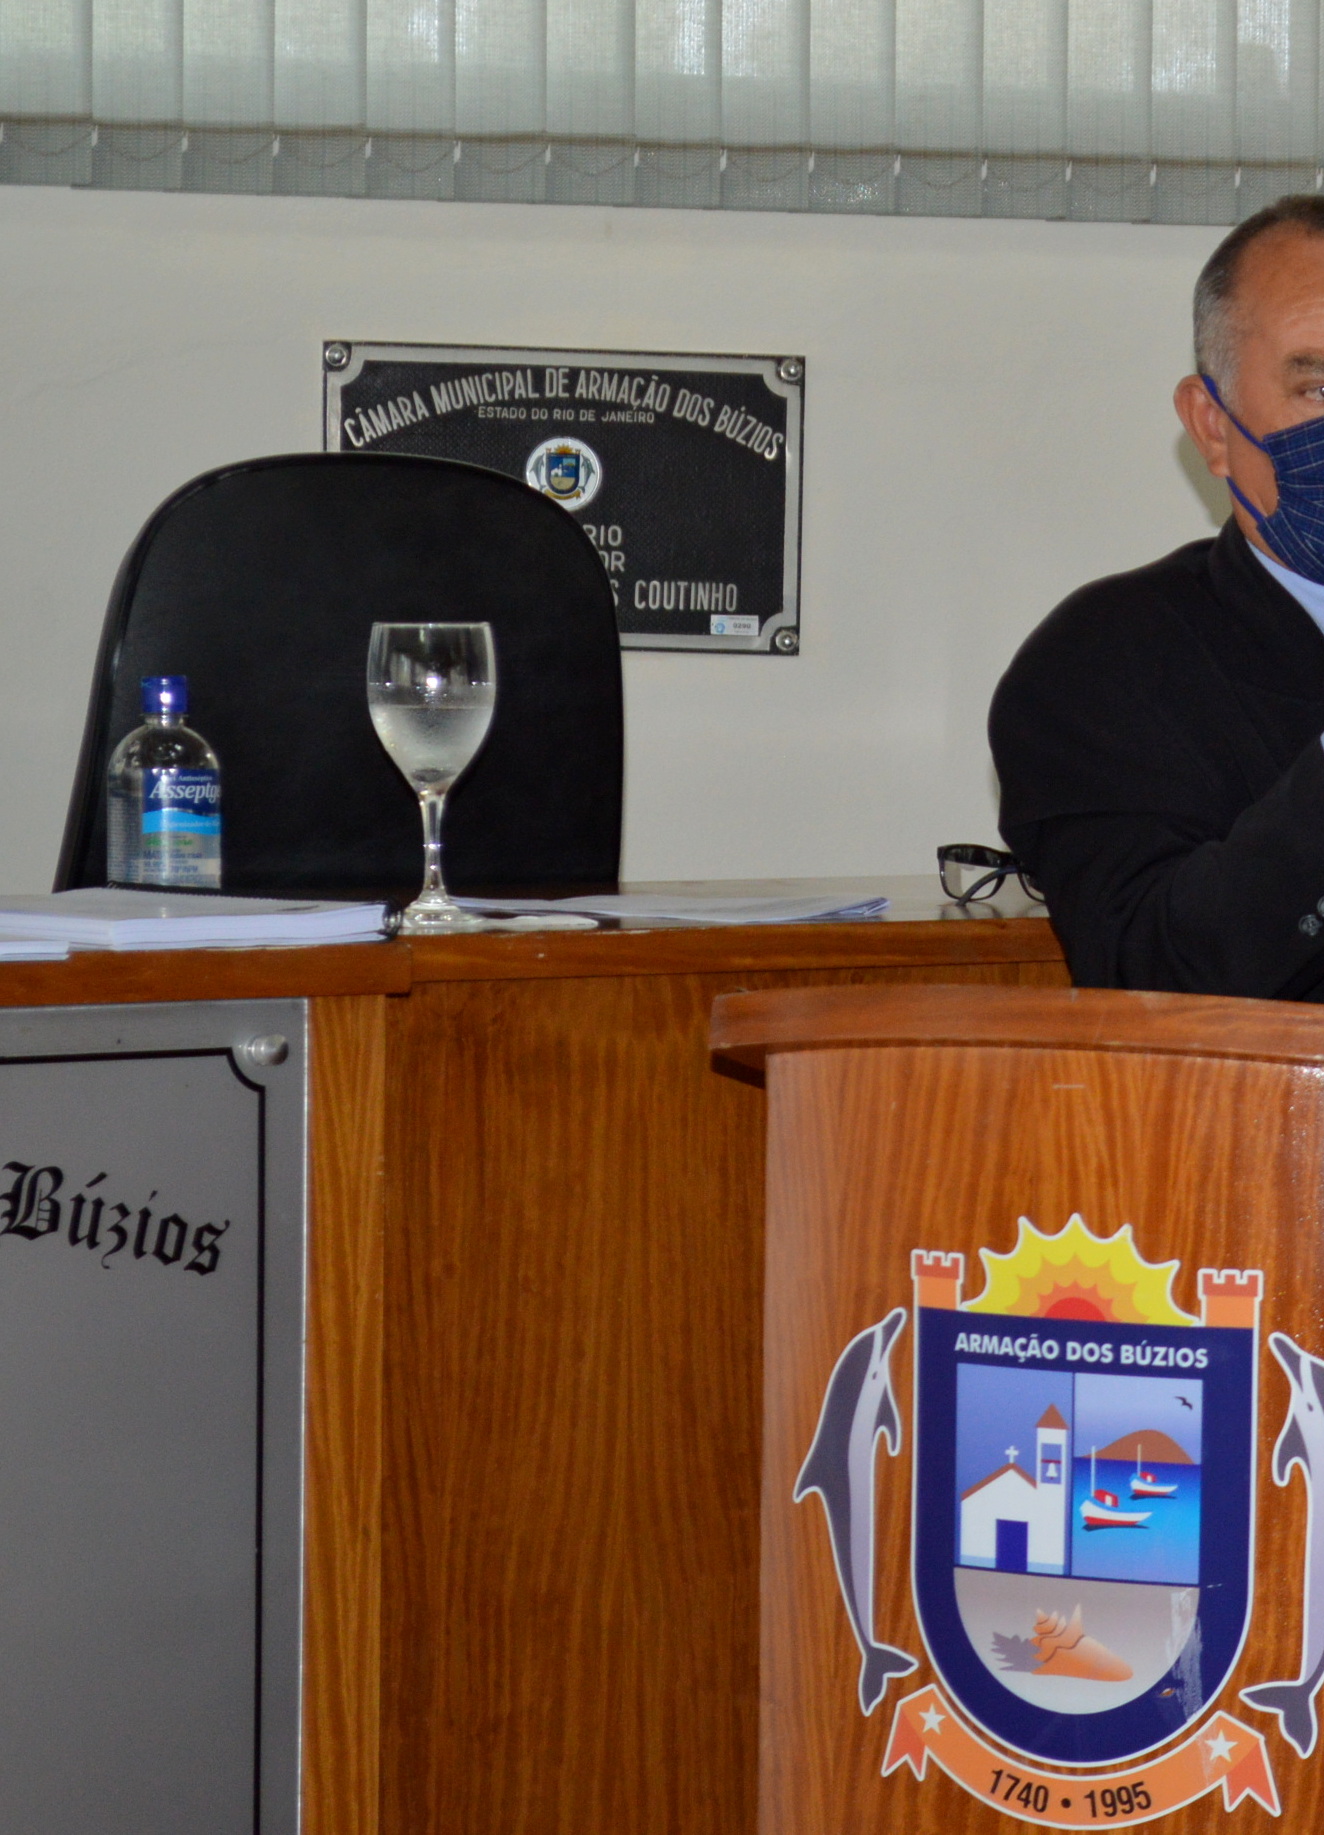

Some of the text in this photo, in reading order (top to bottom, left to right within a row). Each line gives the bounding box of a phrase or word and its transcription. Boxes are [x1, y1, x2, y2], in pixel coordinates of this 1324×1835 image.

[343, 367, 784, 461] CÂMARA MUNICIPAL DE ARMAÇÃO DOS BÚZIOS
[478, 406, 655, 423] ESTADO DO RIO DE JANEIRO
[634, 579, 738, 612] COUTINHO
[0, 1161, 230, 1276] Búzios
[954, 1332, 1209, 1369] ARMAÇÃO DOS BÚZIOS
[989, 1769, 1152, 1818] 1740 1995
